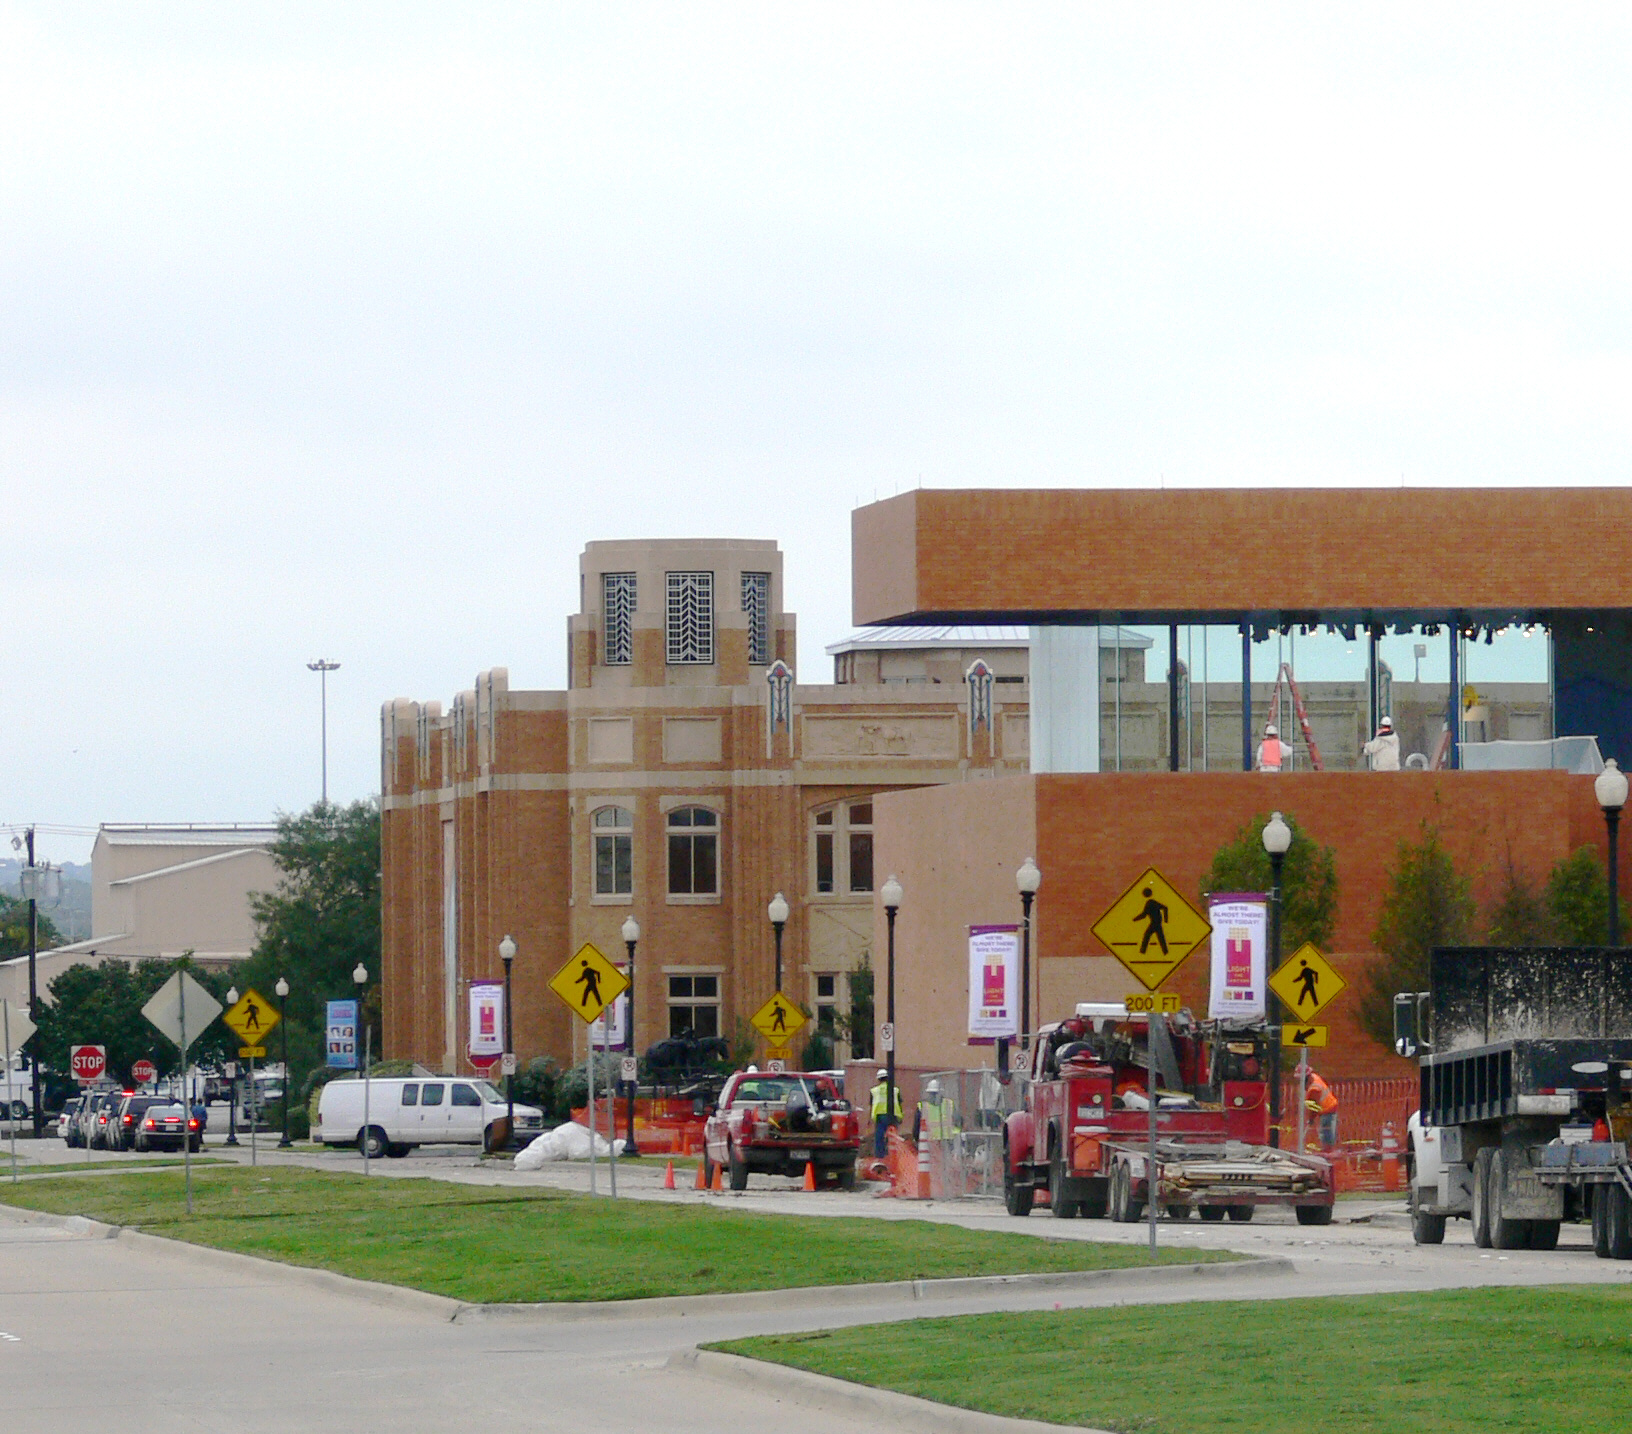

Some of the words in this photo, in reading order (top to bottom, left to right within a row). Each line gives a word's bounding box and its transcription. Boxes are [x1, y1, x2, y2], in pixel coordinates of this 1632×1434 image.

[1126, 997, 1154, 1010] 200
[1162, 996, 1177, 1010] FT
[73, 1056, 103, 1069] STOP
[134, 1067, 152, 1076] STOP
